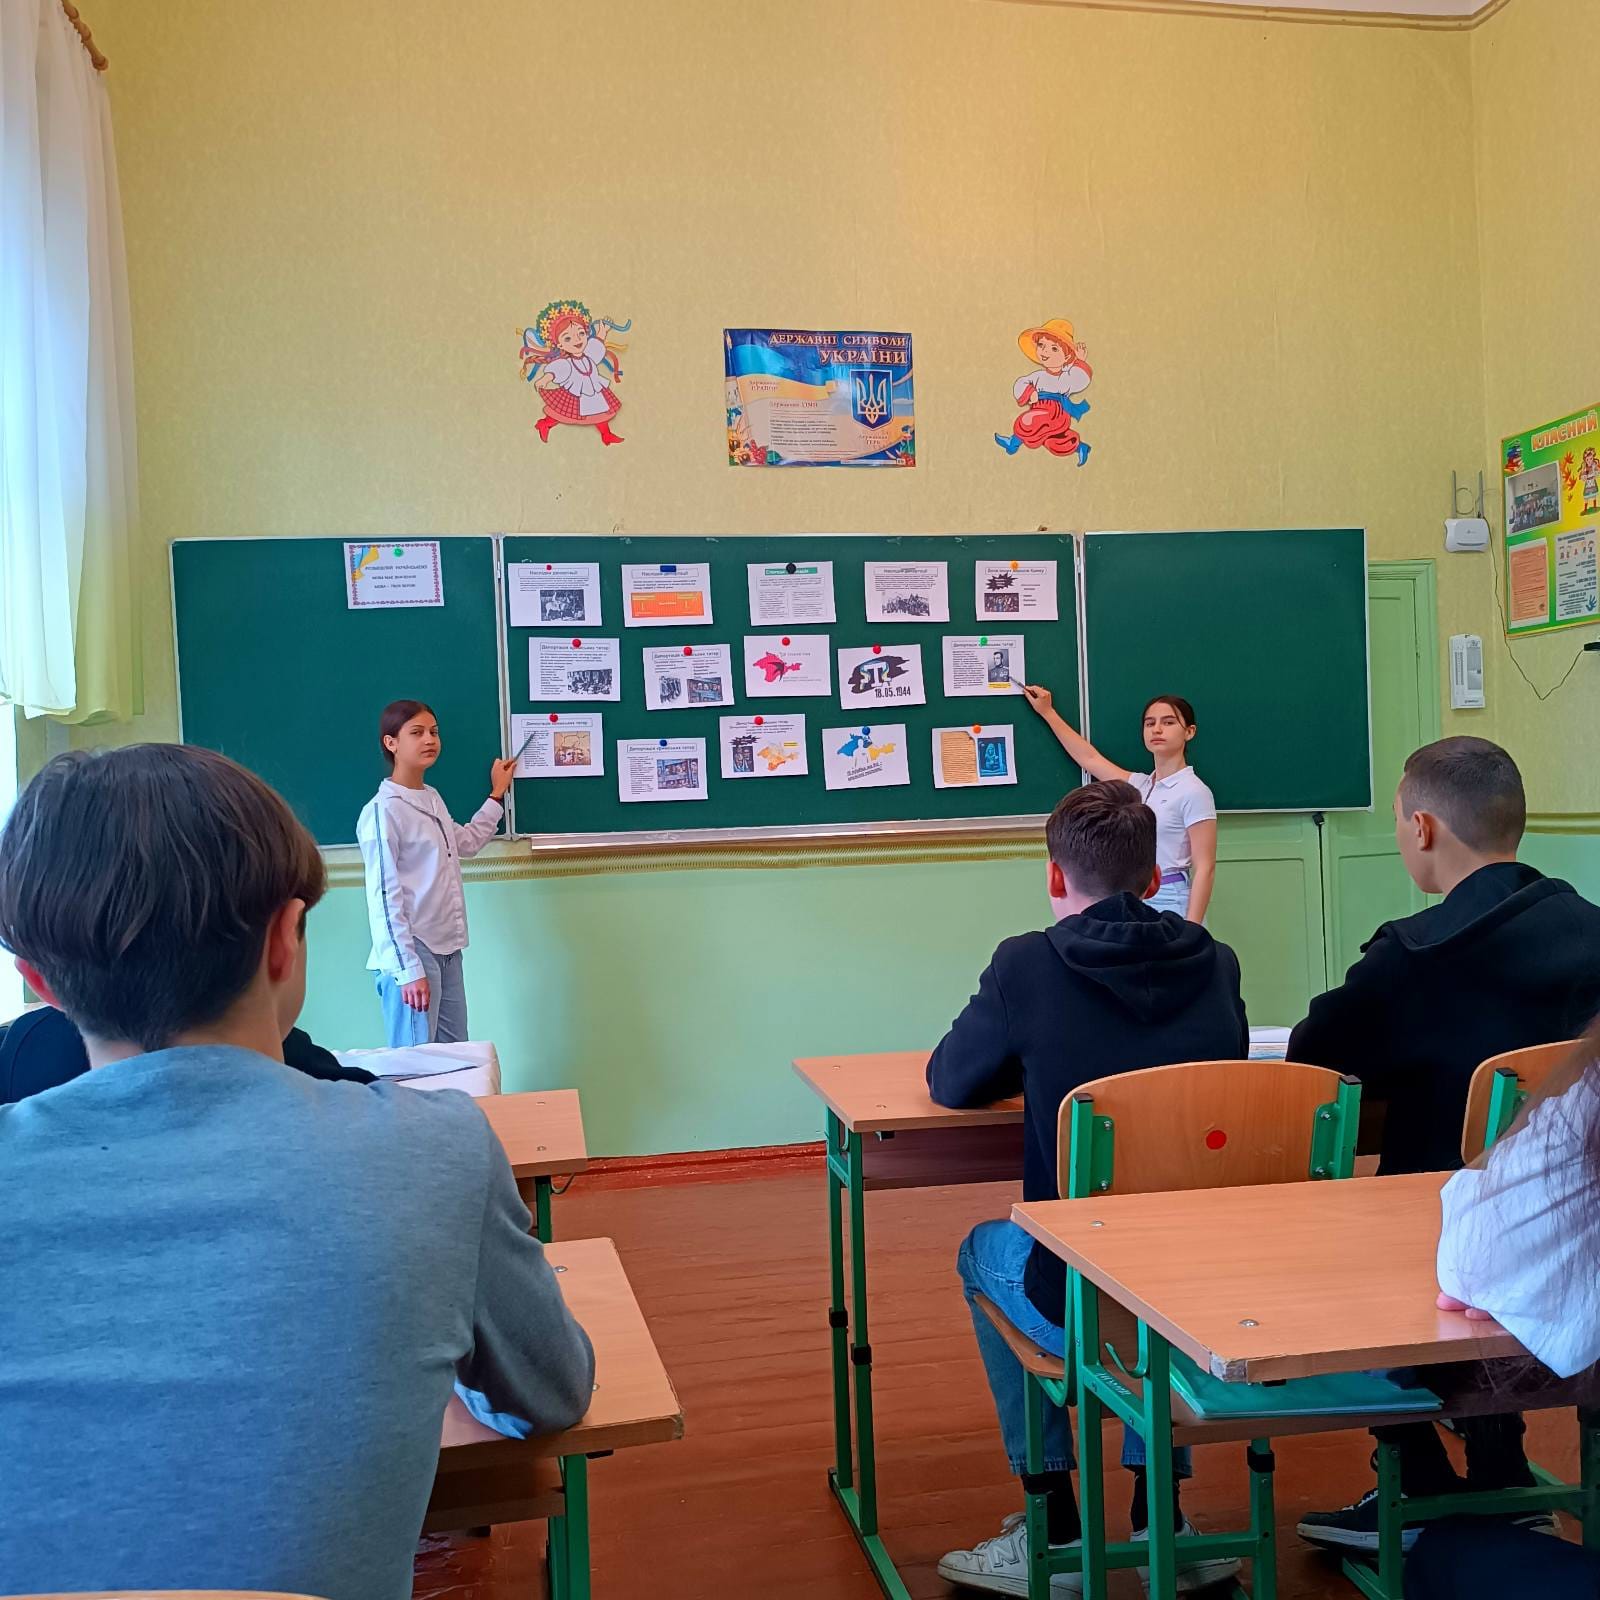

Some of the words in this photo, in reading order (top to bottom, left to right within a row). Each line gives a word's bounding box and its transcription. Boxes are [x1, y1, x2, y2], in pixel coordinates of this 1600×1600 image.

[769, 334, 837, 345] ДЕРЖАВНІ
[843, 335, 907, 346] СИМВОЛИ
[820, 346, 908, 364] УКРАЇНИ
[1531, 410, 1598, 451] КЛАСНИЙ
[875, 686, 911, 698] 18.05.1944
